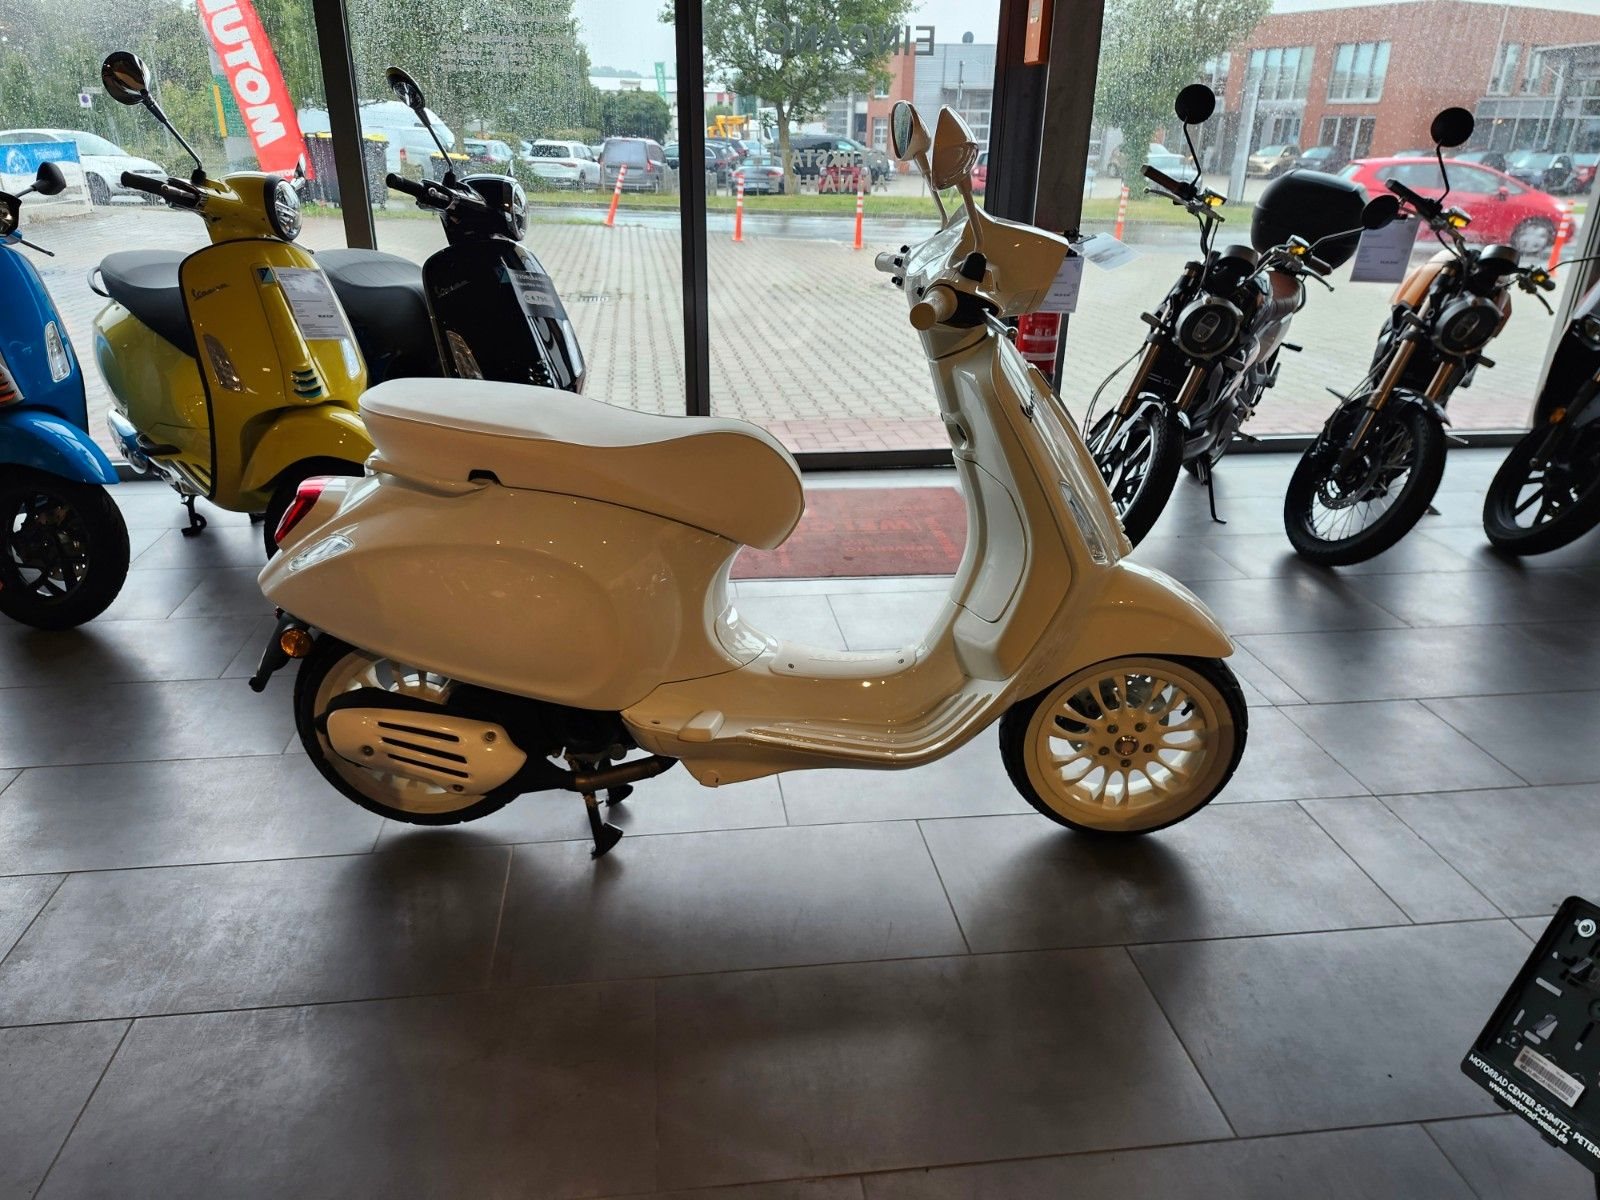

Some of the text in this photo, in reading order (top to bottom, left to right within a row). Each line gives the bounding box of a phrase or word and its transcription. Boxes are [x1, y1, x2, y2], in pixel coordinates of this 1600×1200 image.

[1468, 1053, 1509, 1087] MOTORRAD
[1507, 1083, 1536, 1108] CENTER
[1534, 1103, 1571, 1134] SCHMITZ
